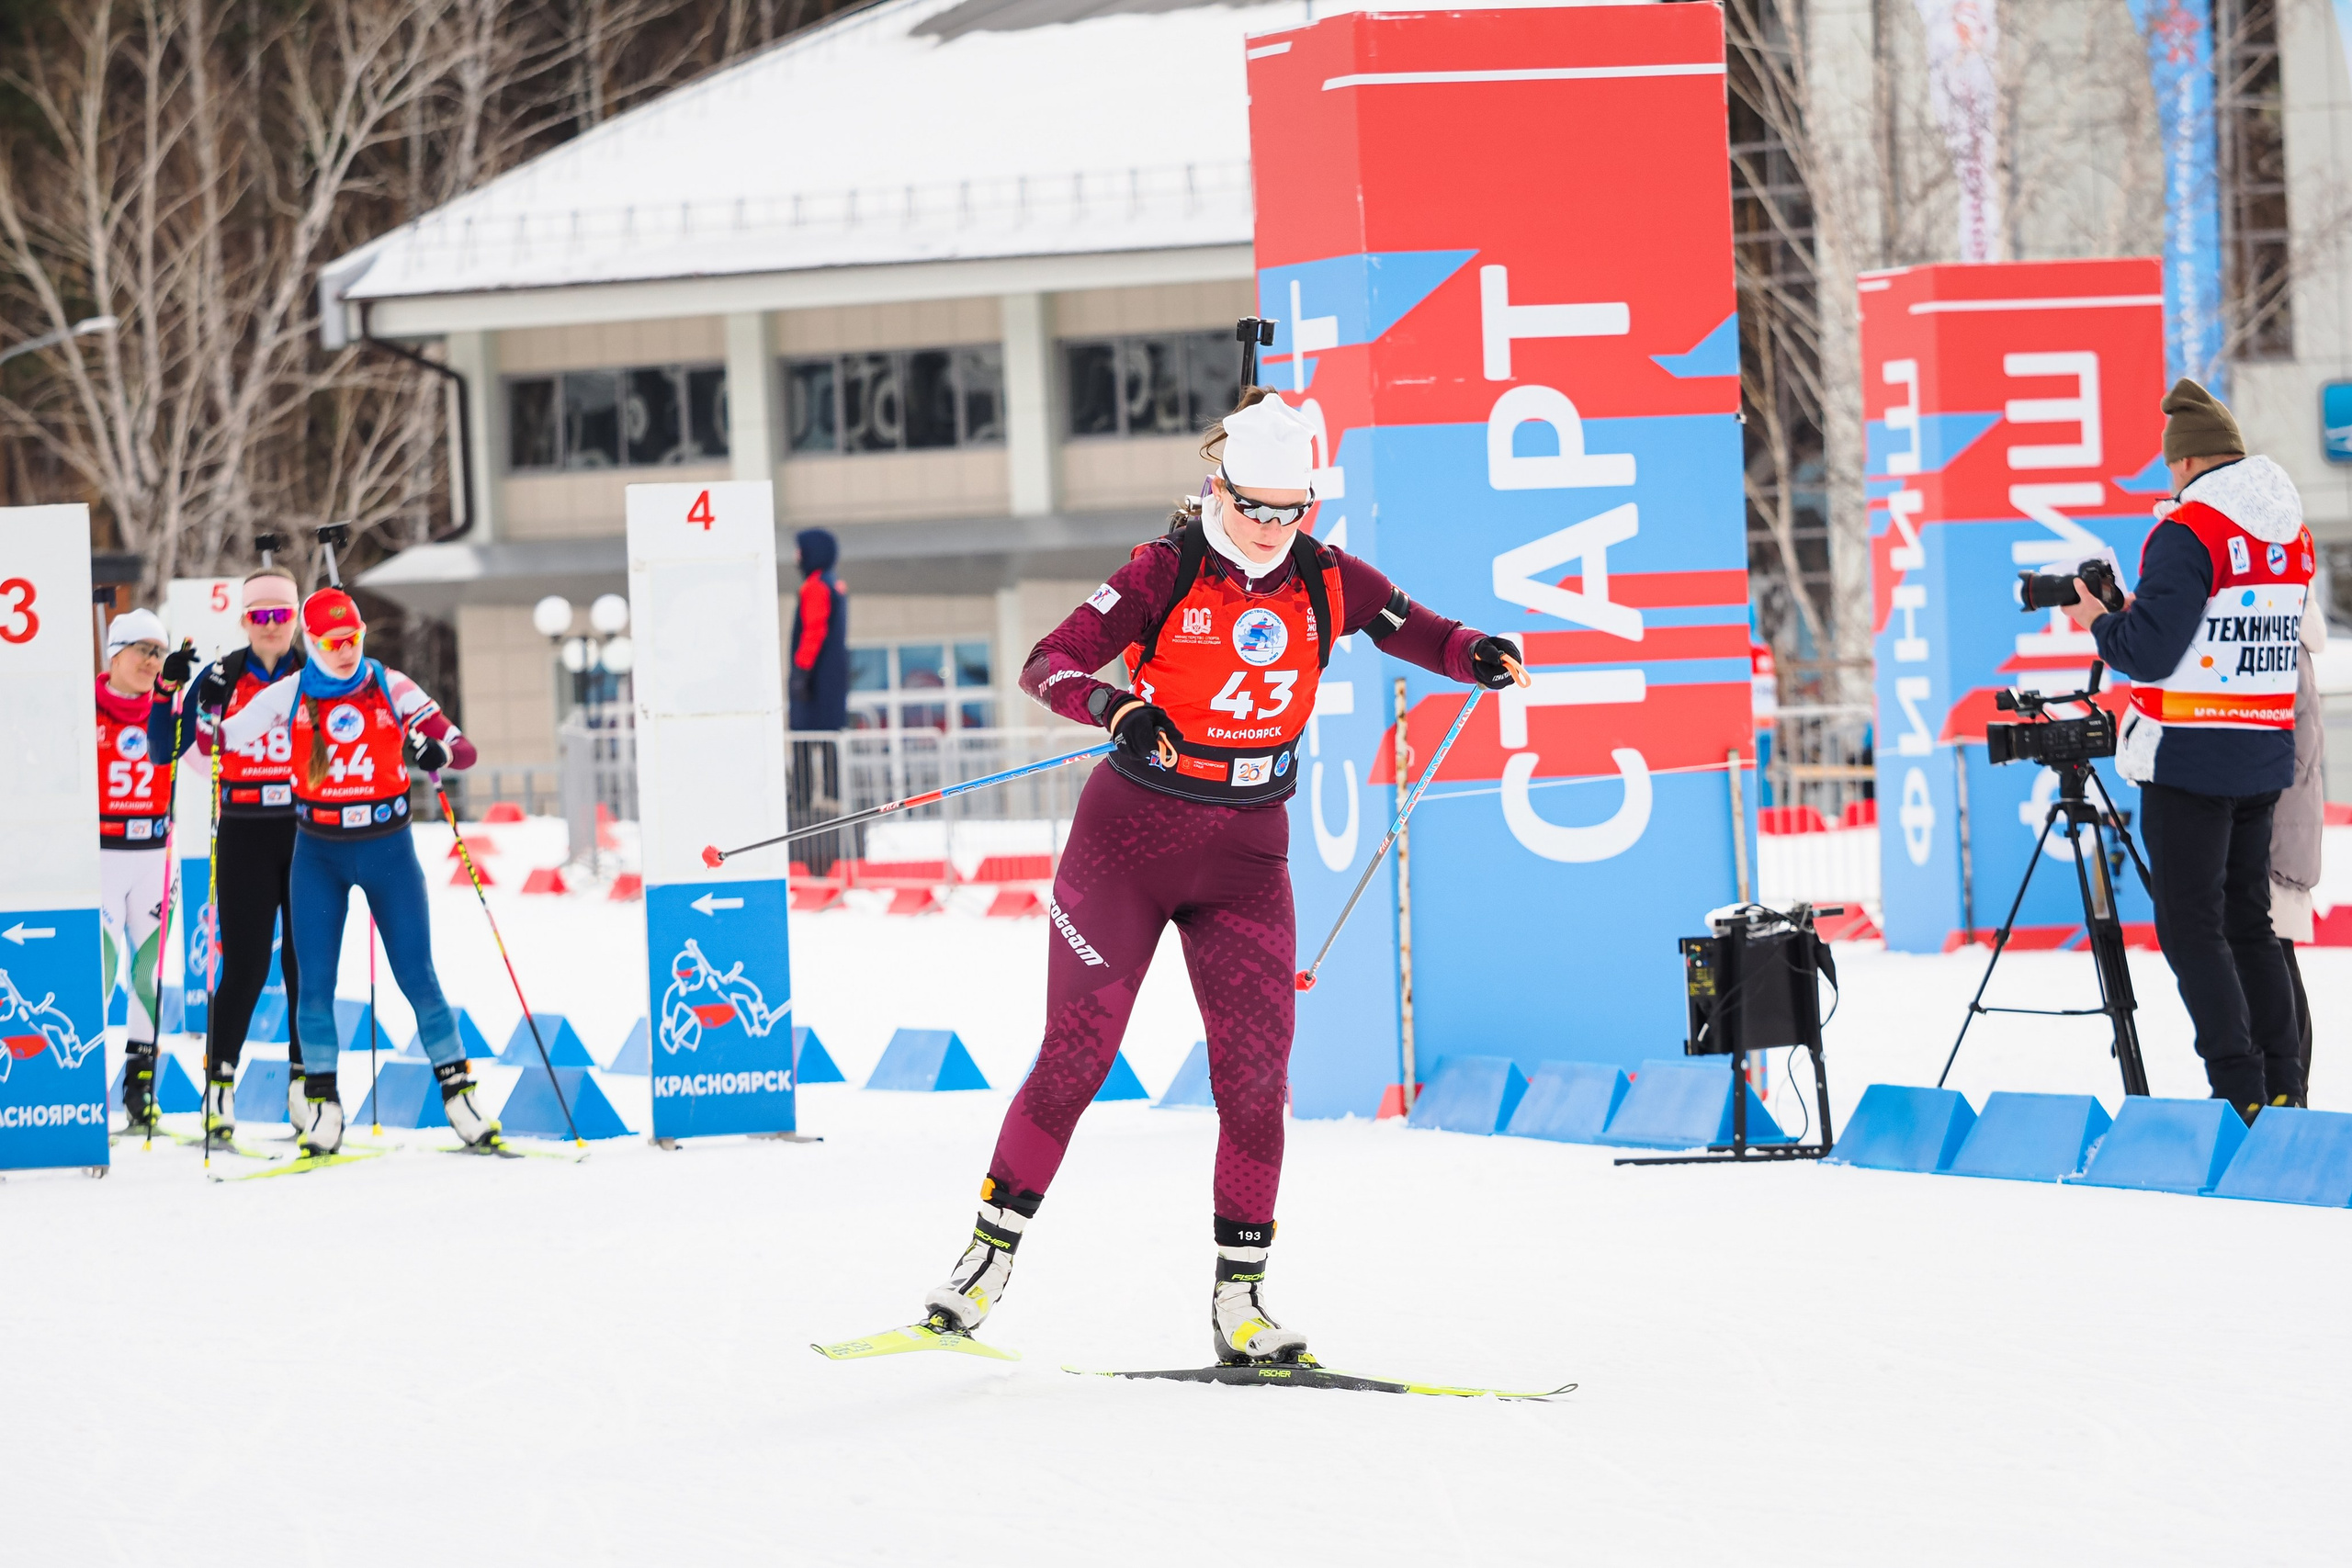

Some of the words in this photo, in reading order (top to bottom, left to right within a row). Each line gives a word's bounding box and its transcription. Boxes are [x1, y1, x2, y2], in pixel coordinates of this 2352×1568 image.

[686, 490, 715, 530] 4
[1289, 280, 1361, 874] СТРТ
[1479, 264, 1653, 863] СТАРТ
[0, 577, 40, 644] 3
[210, 582, 230, 613] 5
[1883, 357, 1935, 866] ФИНИШ
[1237, 609, 1263, 626] ПЕРВЕНСТВО
[1263, 610, 1282, 625] РОССИИ
[2206, 615, 2301, 642] ТЕХНИЧЕС
[1210, 669, 1299, 720] 43
[239, 726, 292, 762] 48
[1206, 726, 1283, 740] КРАСНОЯРСК
[108, 761, 154, 797] 52
[326, 743, 375, 783] 44
[653, 1069, 793, 1099] КРАСНОЯРСК
[0, 1102, 105, 1127] СНОЯРСК
[1237, 1230, 1261, 1241] 193
[1258, 1369, 1292, 1378] FISCHER
